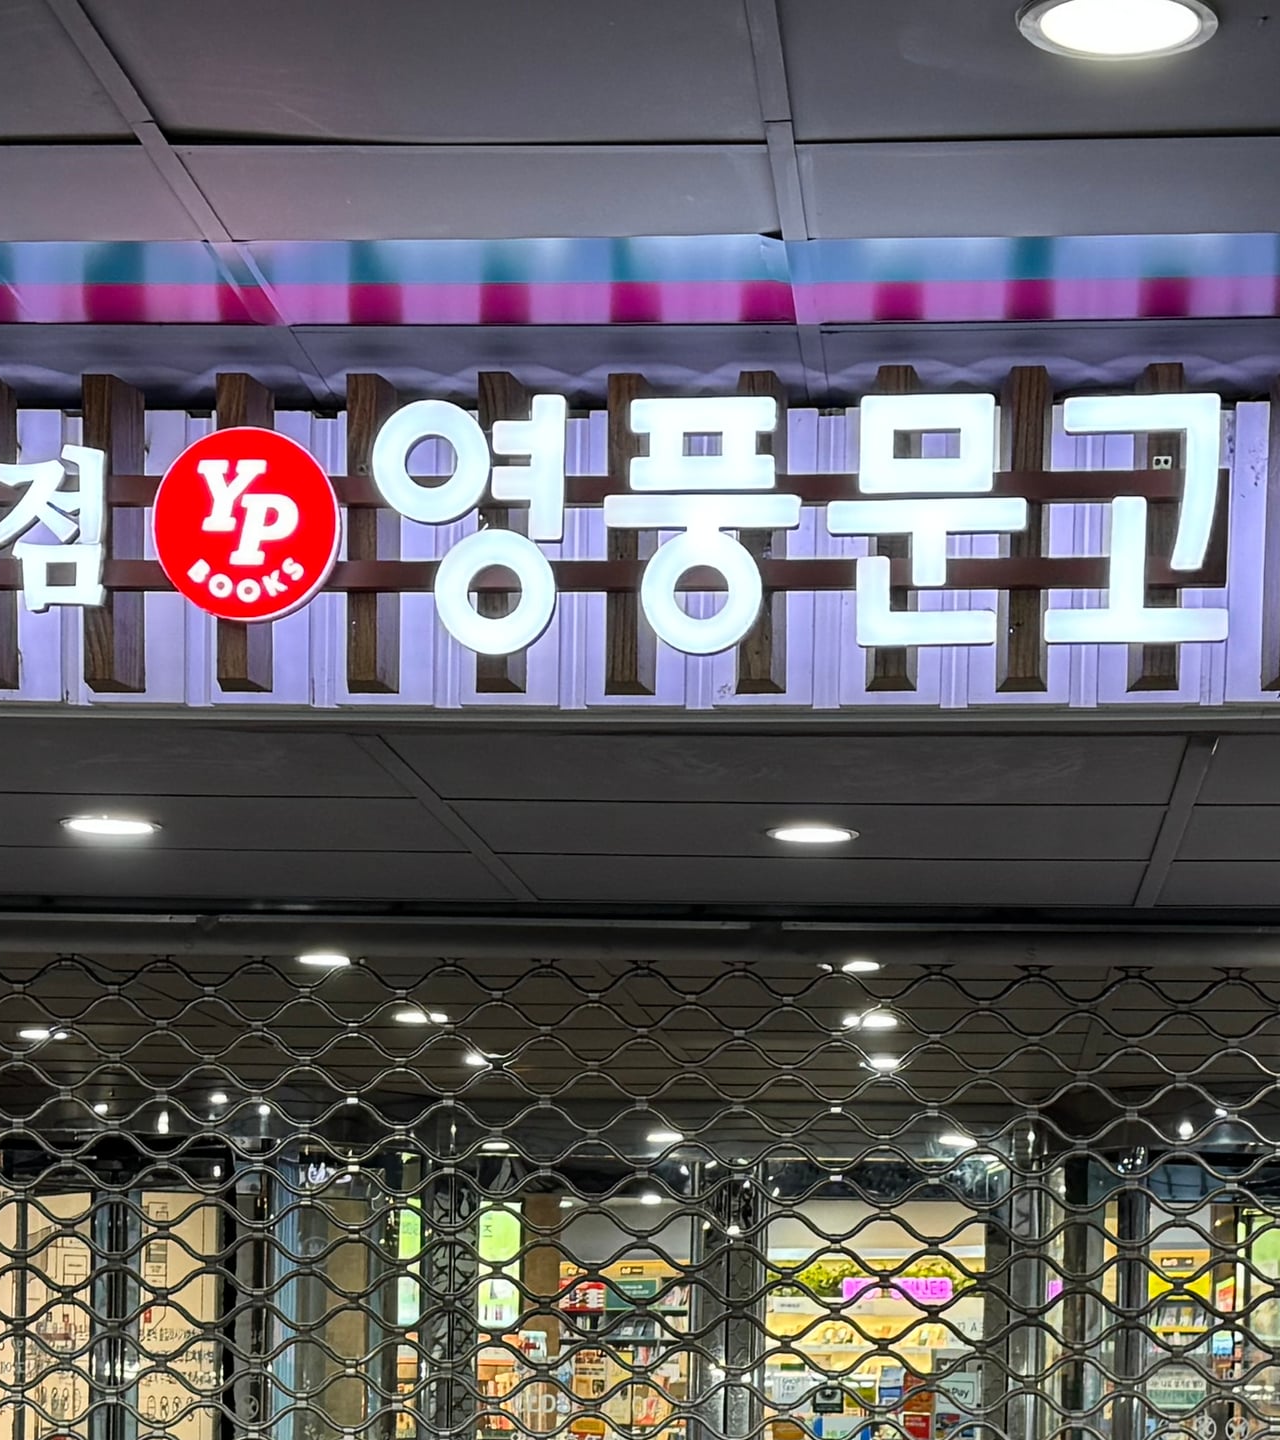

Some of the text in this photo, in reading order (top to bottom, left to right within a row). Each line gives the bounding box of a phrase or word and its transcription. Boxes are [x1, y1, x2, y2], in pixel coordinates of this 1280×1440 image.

[196, 458, 300, 567] YP
[371, 393, 1230, 656] 영풍문고
[186, 556, 306, 604] BOOKS
